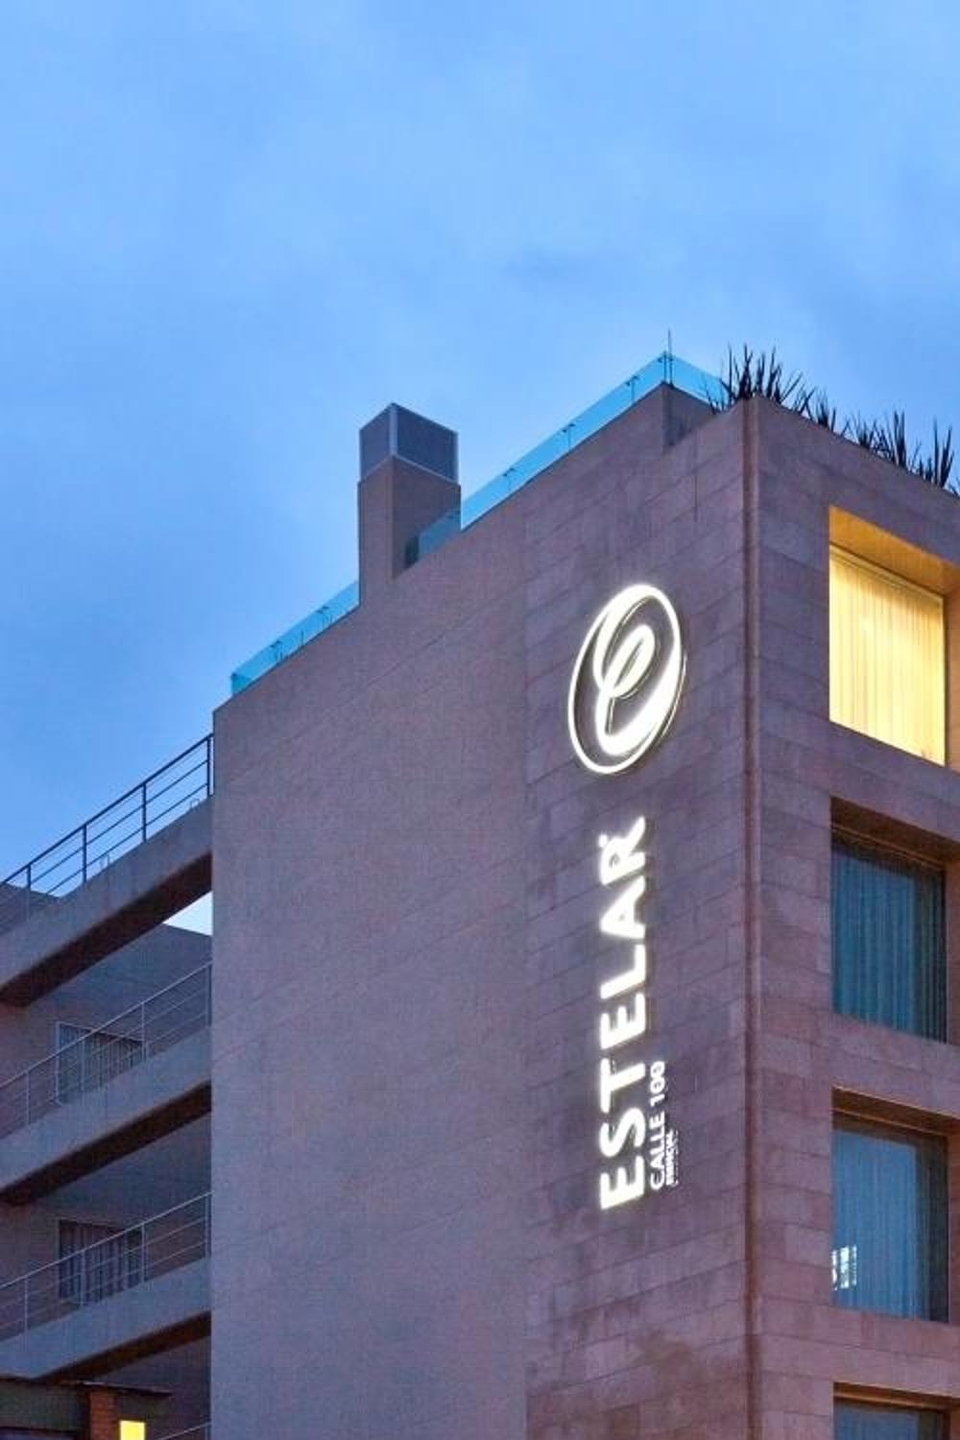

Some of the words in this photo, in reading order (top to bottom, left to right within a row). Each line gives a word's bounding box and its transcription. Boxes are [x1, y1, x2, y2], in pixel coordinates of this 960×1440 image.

[598, 816, 646, 1210] ESTELAR
[649, 1060, 666, 1106] 100
[649, 1111, 666, 1190] CALLE
